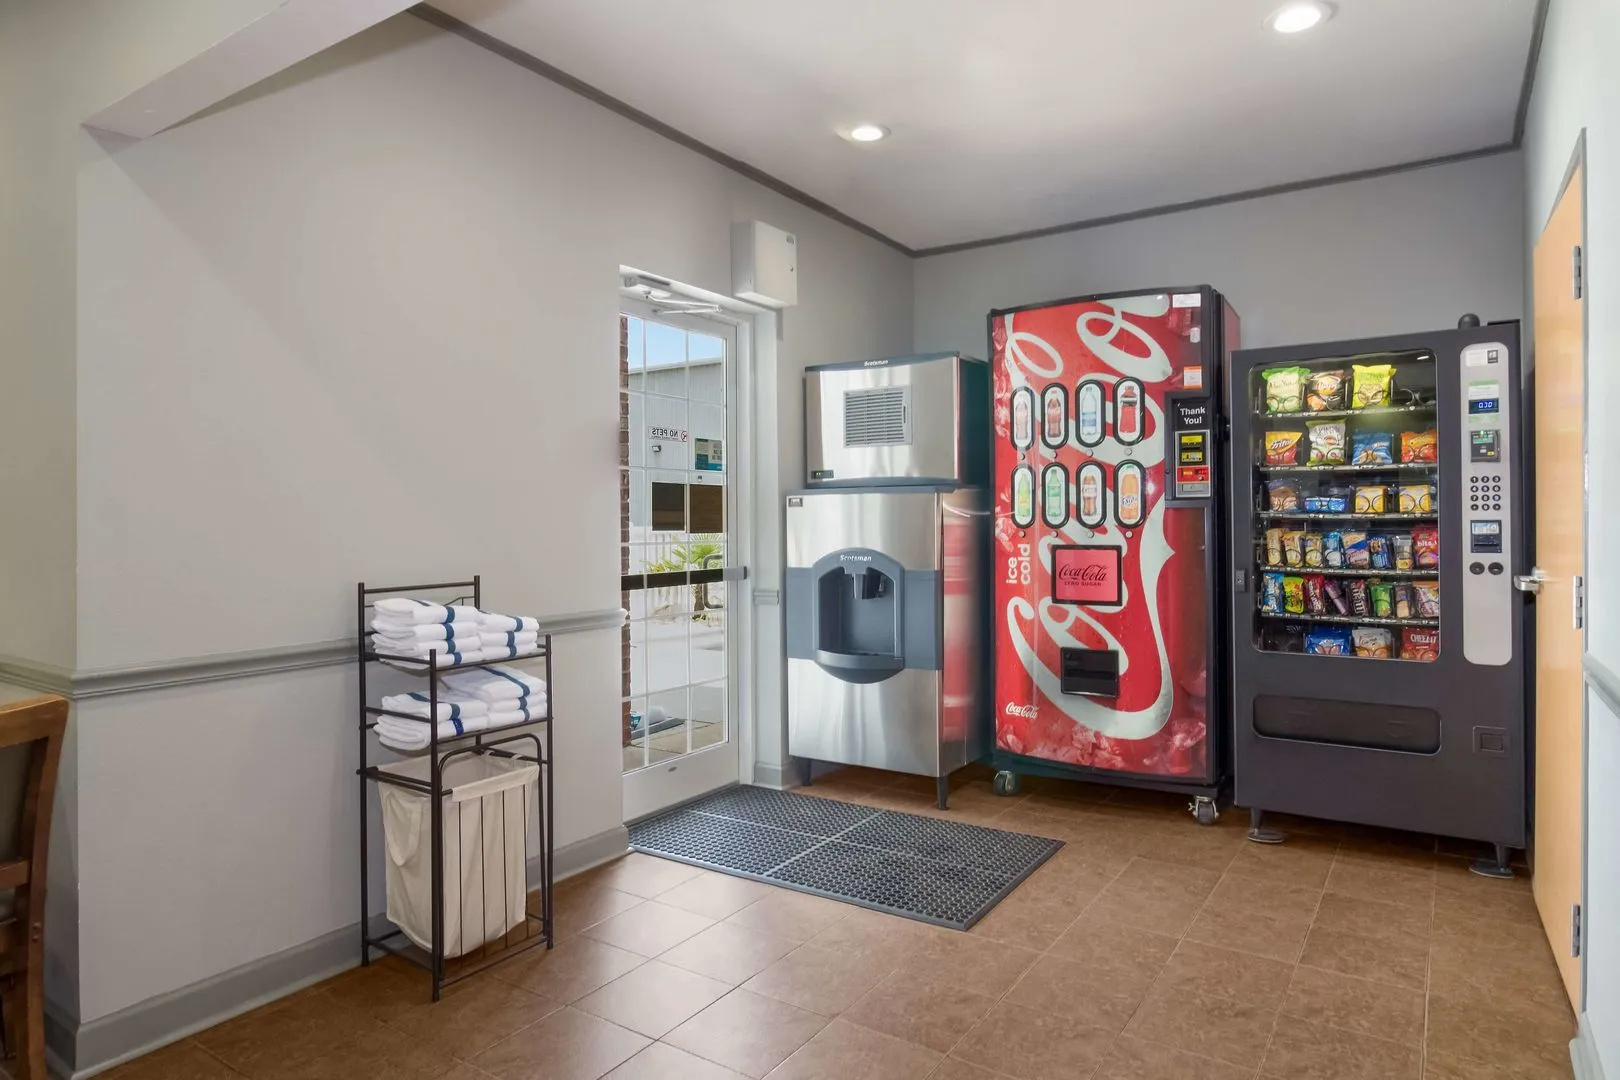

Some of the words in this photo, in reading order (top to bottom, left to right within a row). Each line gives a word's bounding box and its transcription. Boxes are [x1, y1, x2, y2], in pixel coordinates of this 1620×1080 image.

[1180, 406, 1206, 416] Thank
[1184, 417, 1202, 425] You!
[1006, 556, 1018, 584] ice
[1017, 543, 1031, 585] cold
[1059, 563, 1107, 581] Coca-Cola
[1006, 701, 1038, 719] Coca-Cola
